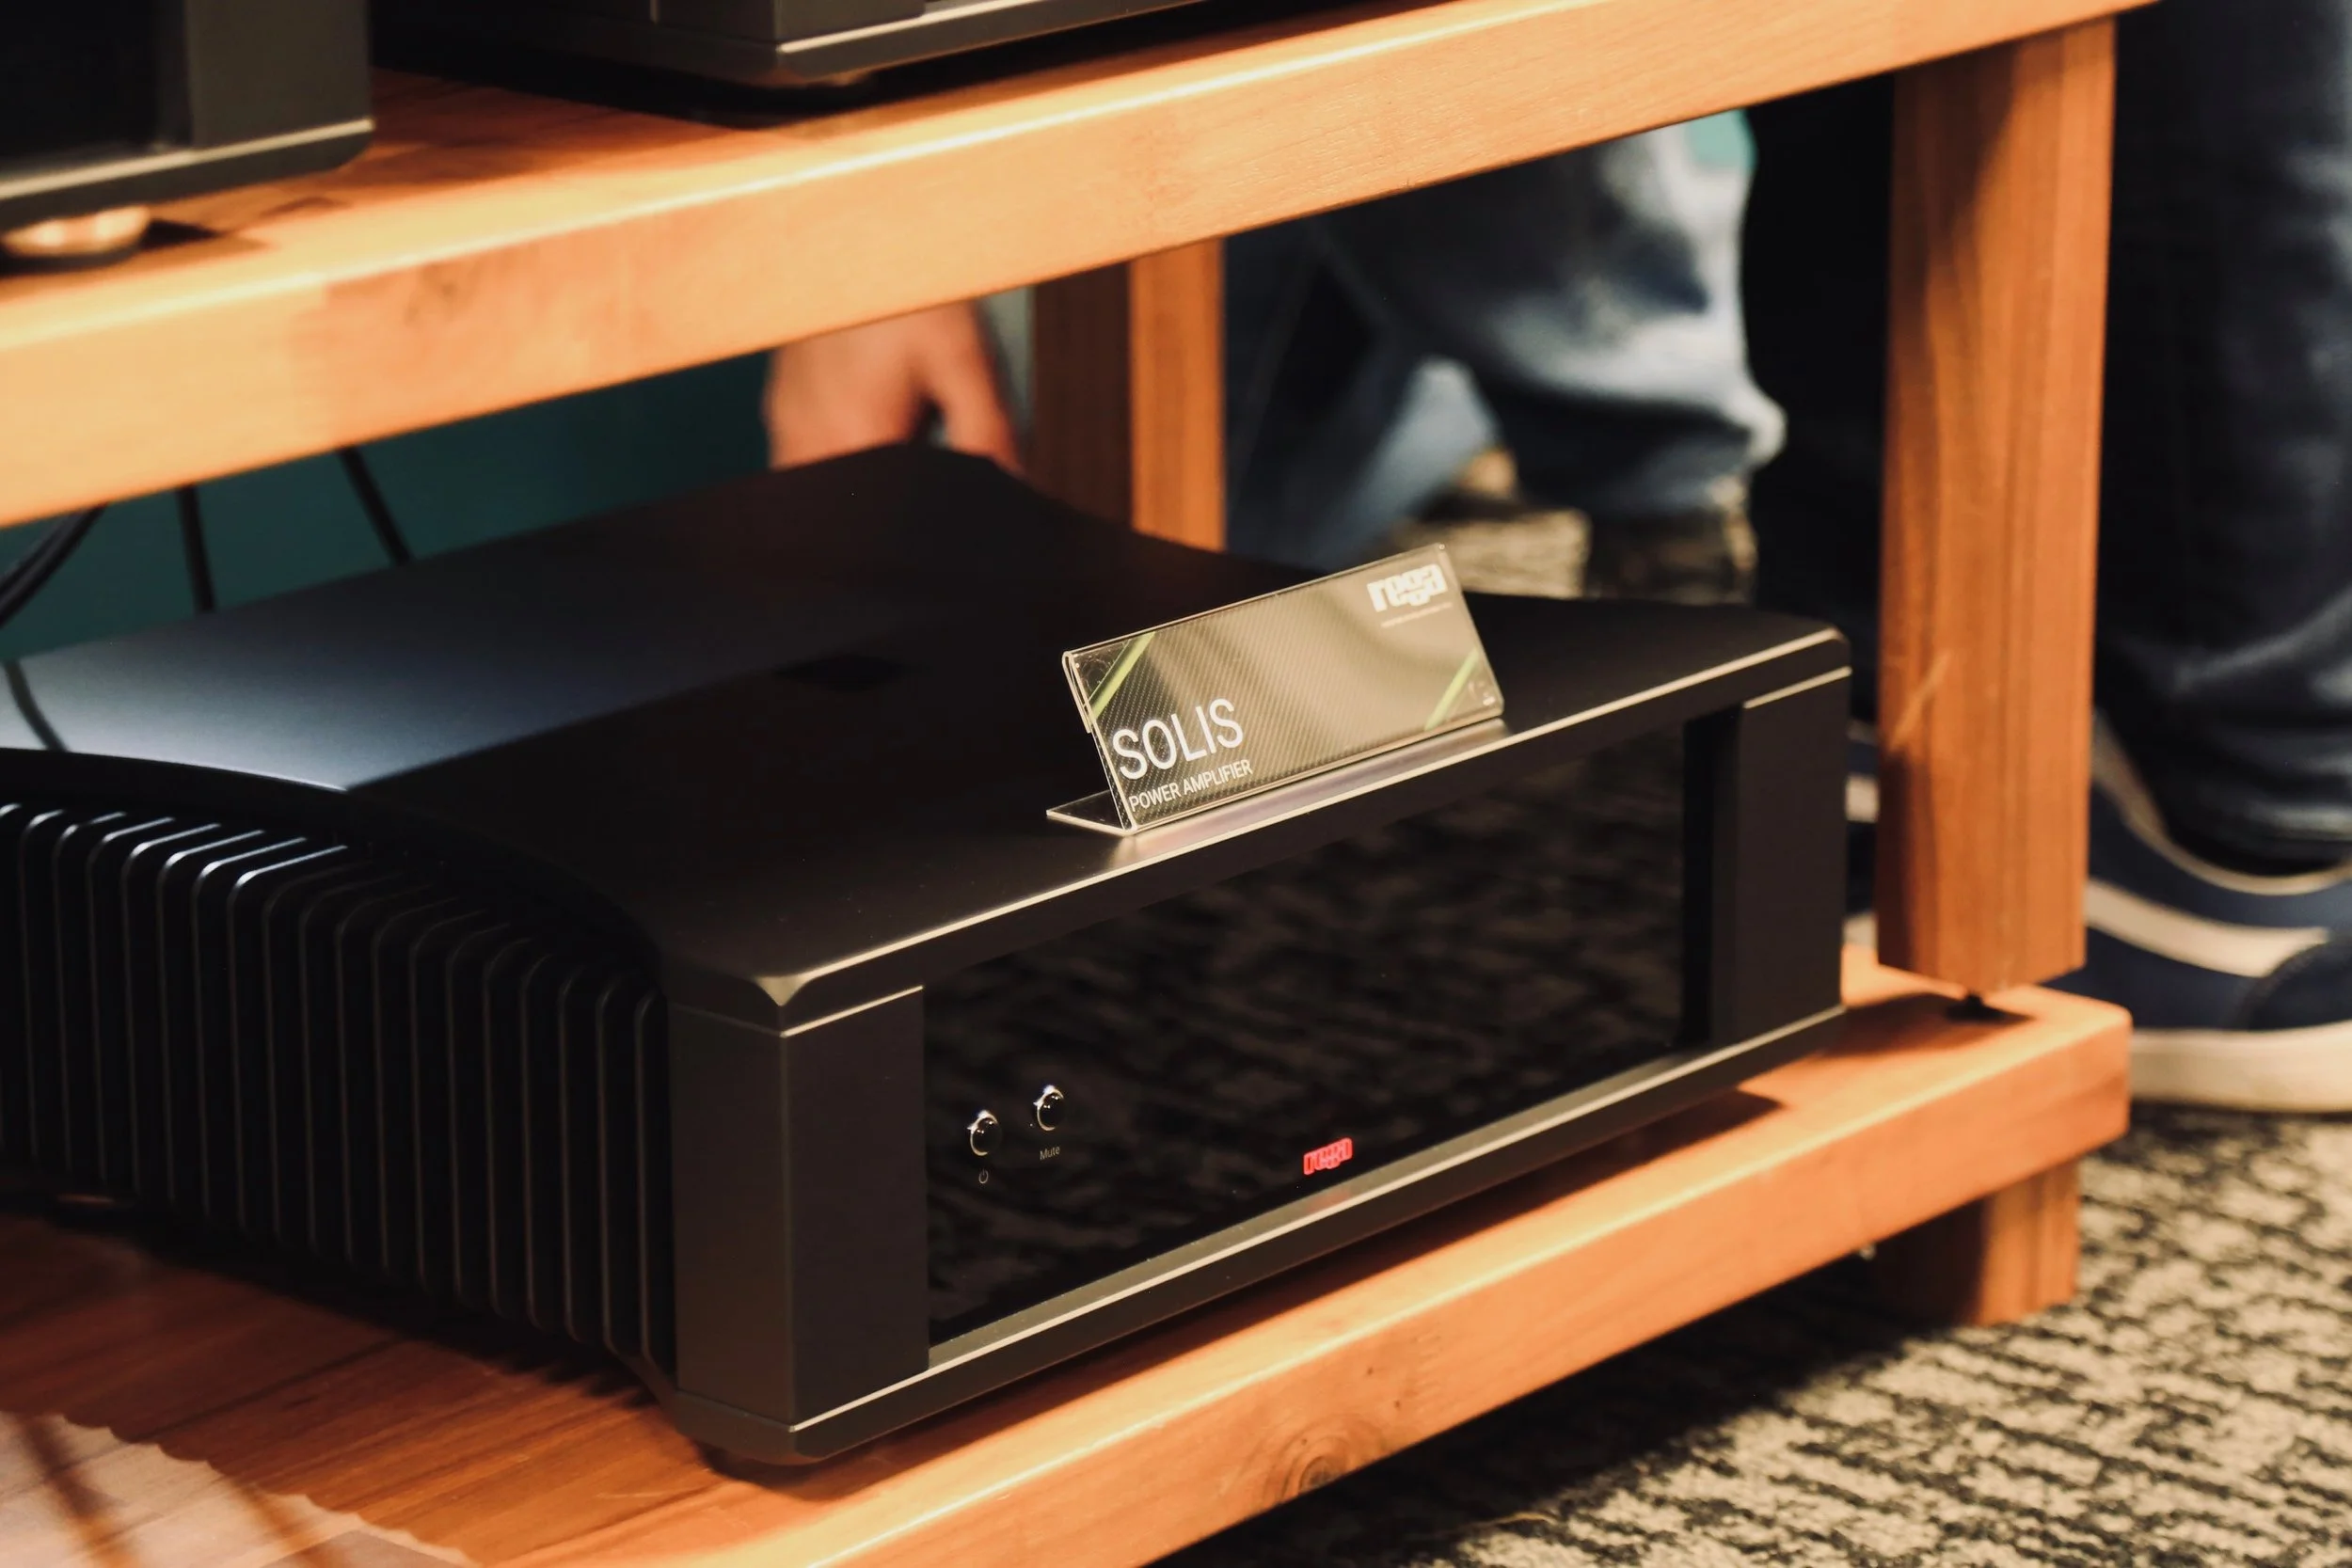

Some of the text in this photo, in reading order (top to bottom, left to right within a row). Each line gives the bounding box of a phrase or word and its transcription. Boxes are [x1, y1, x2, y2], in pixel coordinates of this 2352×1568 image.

[1367, 563, 1448, 613] rega
[1112, 698, 1244, 780] SOLIS
[1129, 759, 1253, 813] POWER AMPLIFIER
[1040, 1146, 1060, 1161] Mute
